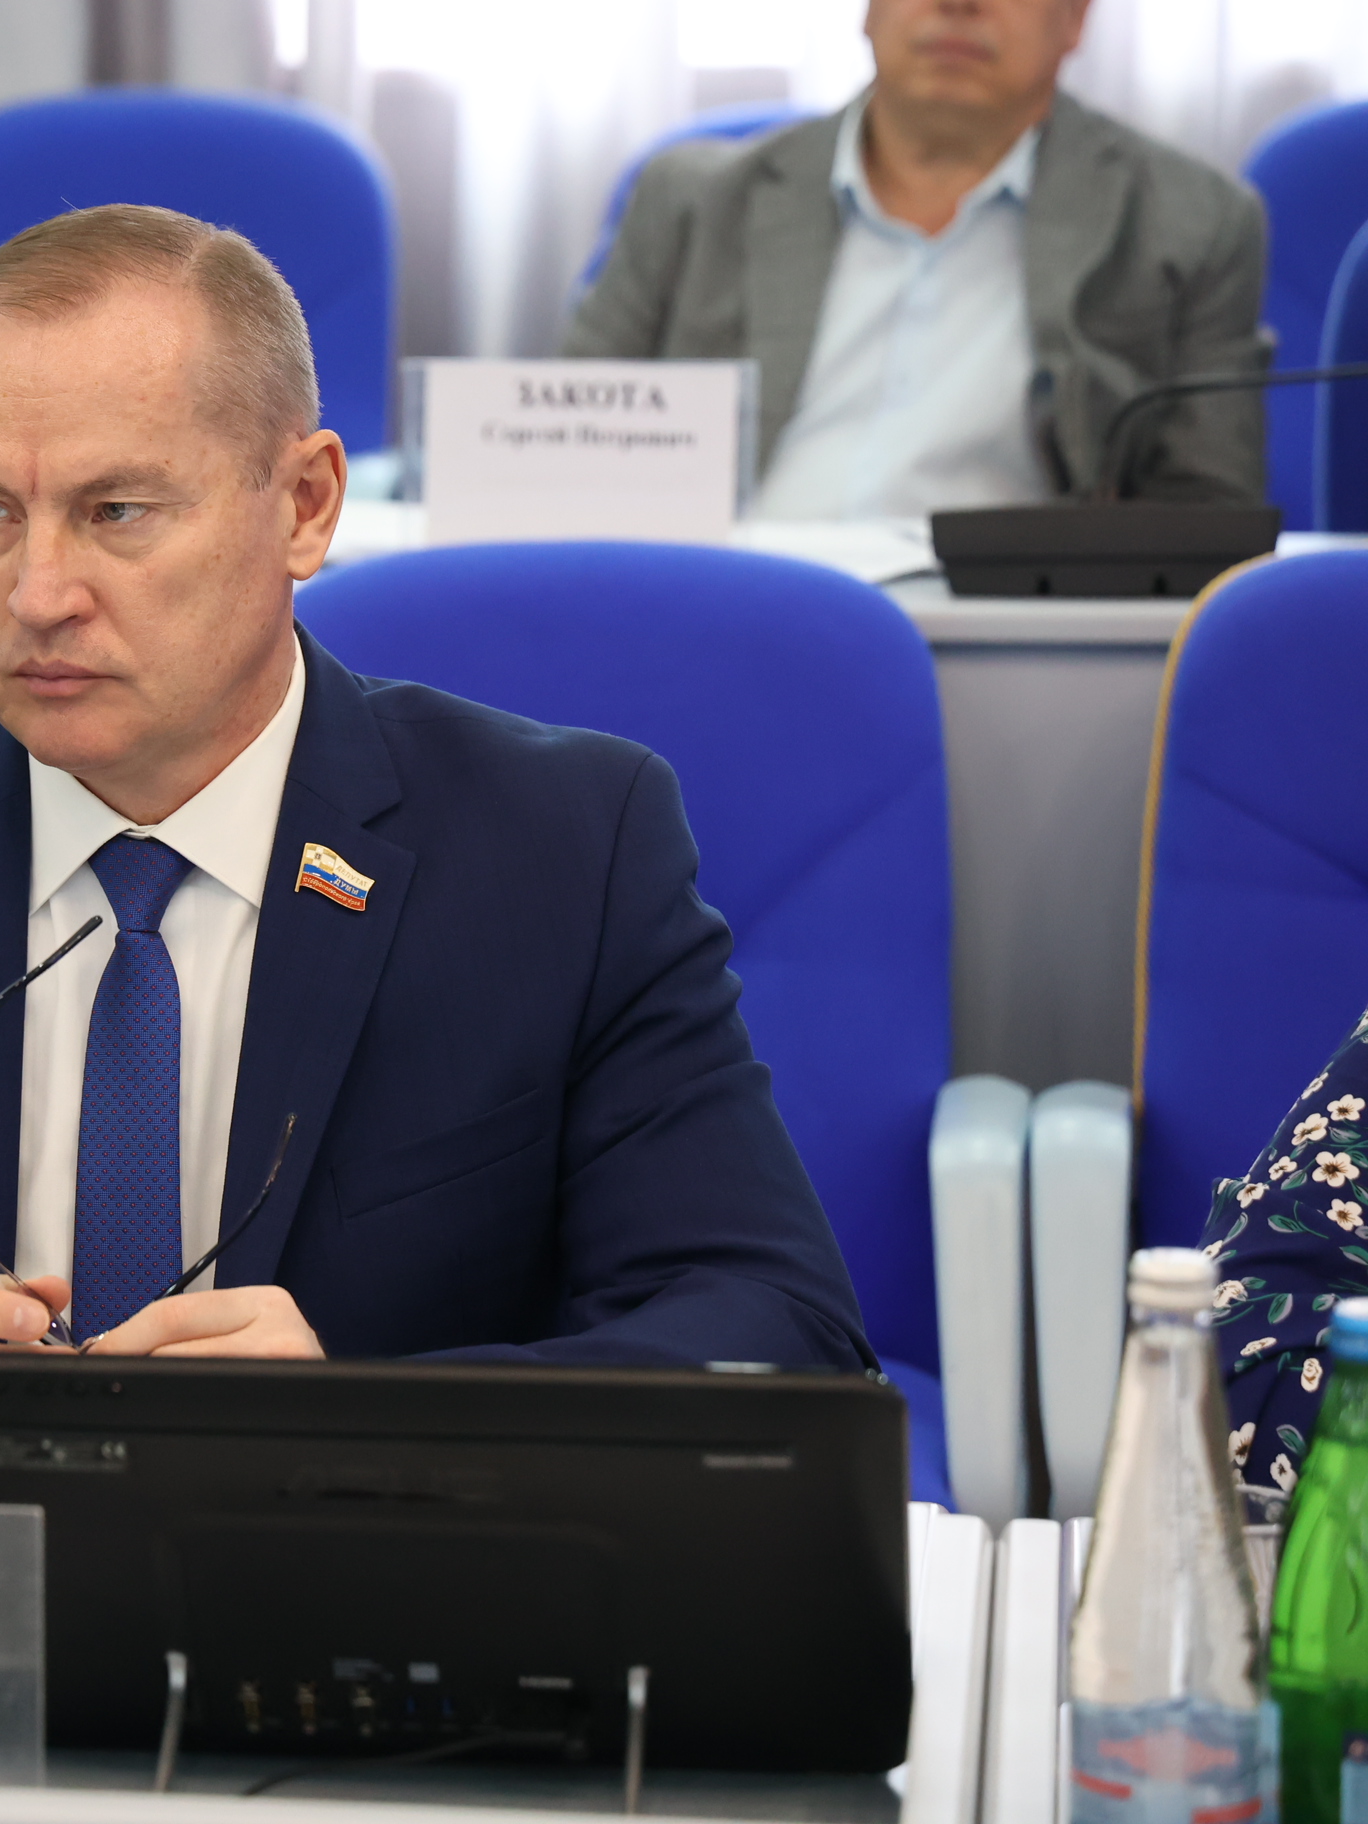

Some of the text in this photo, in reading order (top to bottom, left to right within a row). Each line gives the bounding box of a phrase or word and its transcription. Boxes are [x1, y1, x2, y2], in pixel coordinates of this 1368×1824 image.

[518, 377, 668, 411] ЗАКОТА
[334, 878, 359, 896] ДУМЫ
[335, 865, 367, 887] ДЕПУТАТ
